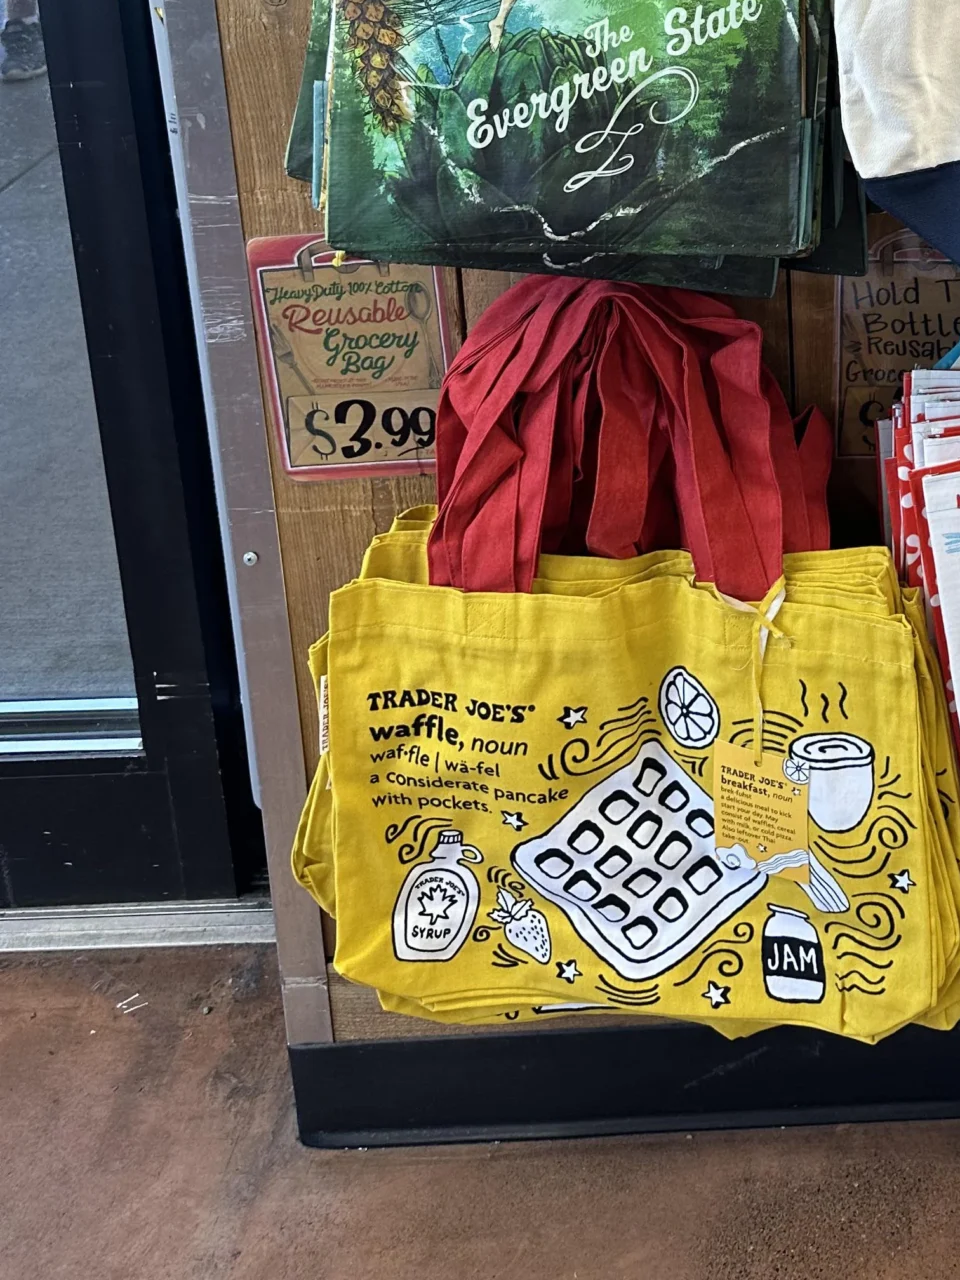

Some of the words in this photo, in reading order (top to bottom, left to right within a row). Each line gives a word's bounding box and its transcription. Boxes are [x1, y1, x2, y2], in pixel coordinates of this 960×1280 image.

[583, 17, 635, 59] The
[466, 46, 653, 150] Evergreen
[265, 286, 313, 306] Heavy
[311, 282, 346, 301] Duty
[348, 281, 372, 296] 100%
[374, 280, 424, 295] Cotton
[851, 277, 920, 310] Hold
[281, 297, 412, 335] Reusable
[323, 328, 419, 367] Grocery
[867, 336, 957, 361] Reusab
[340, 351, 396, 380] Bag
[844, 360, 905, 384] Groc
[304, 399, 438, 461] $3.99
[366, 688, 458, 712] TRADER
[369, 713, 465, 753] waffle,
[471, 737, 529, 756] noun
[720, 764, 756, 782] TRADER
[369, 773, 380, 784] a
[386, 771, 490, 794] considerate
[494, 788, 569, 804] pancake
[720, 774, 771, 798] breakfast,
[772, 793, 793, 803] noun
[371, 792, 413, 808] with
[418, 795, 493, 814] pockets.
[720, 802, 735, 811] start
[736, 806, 751, 815] your
[726, 794, 753, 808] delicious
[754, 803, 770, 812] meal
[779, 810, 792, 819] kick
[721, 810, 742, 820] consist
[777, 825, 796, 835] cereal
[721, 824, 736, 833] Also
[736, 828, 761, 840] leftover
[762, 836, 776, 844] Thai
[760, 828, 775, 837] cold
[414, 876, 444, 890] TRADER
[411, 925, 452, 939] SYRUP
[767, 942, 819, 976] JAM
